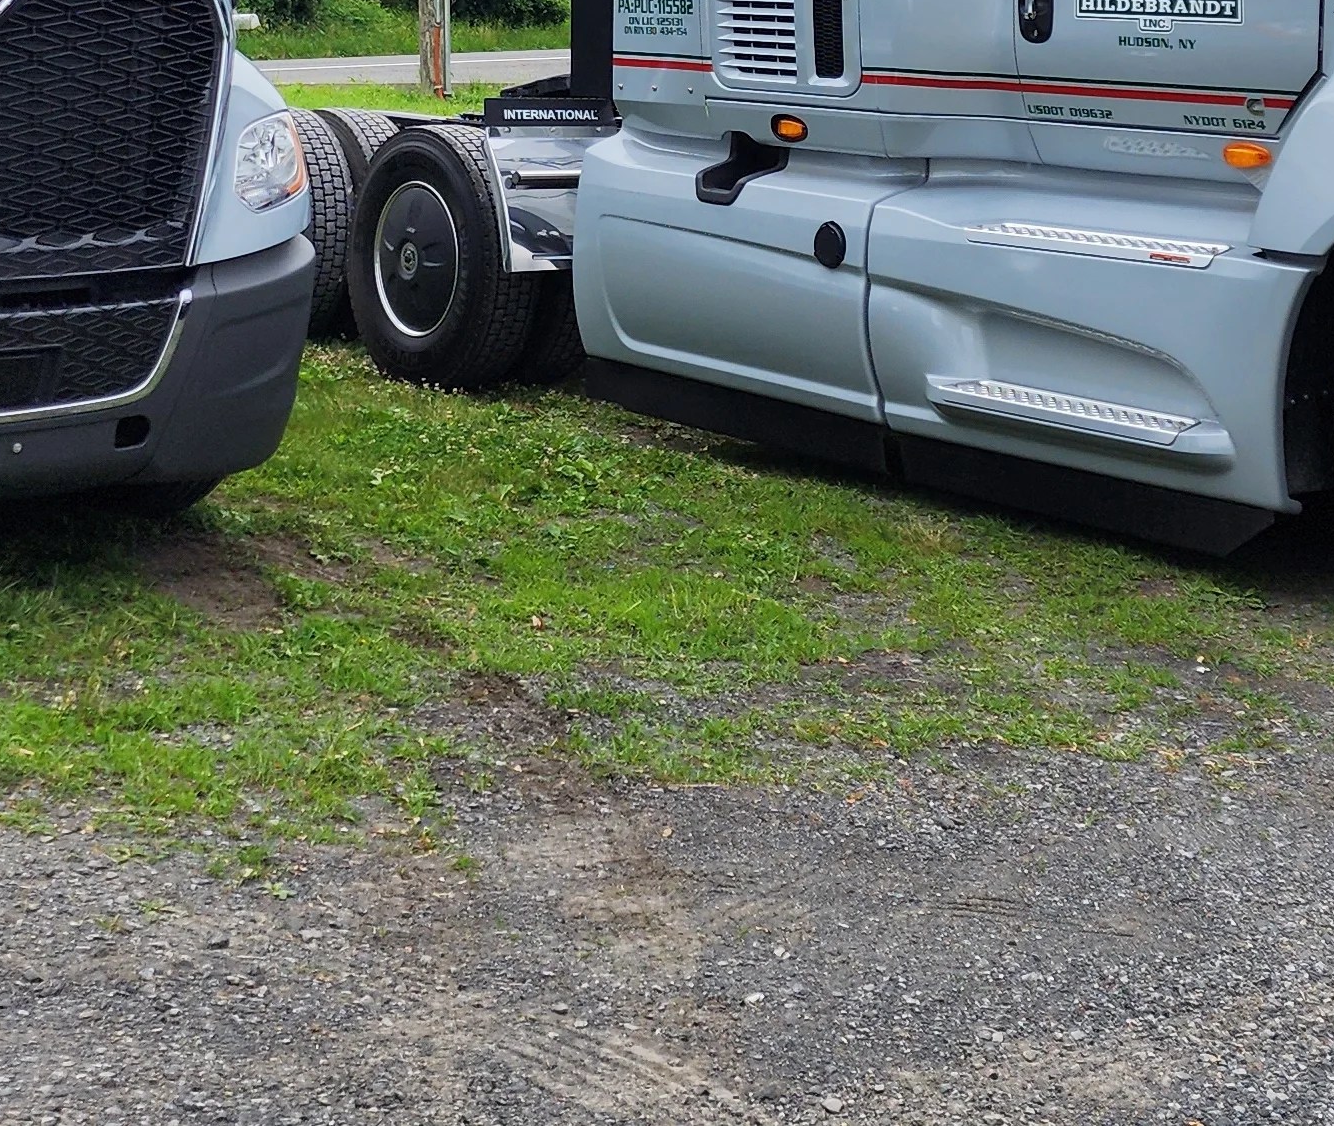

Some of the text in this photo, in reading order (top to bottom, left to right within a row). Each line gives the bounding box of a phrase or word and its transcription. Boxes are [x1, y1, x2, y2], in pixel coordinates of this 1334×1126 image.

[1142, 18, 1170, 29] INC.
[1118, 35, 1197, 51] HUDSON, NY
[503, 108, 599, 121] INTERNATIONAL
[1027, 104, 1065, 117] USDOT
[1183, 114, 1267, 131] NYDOT 6124
